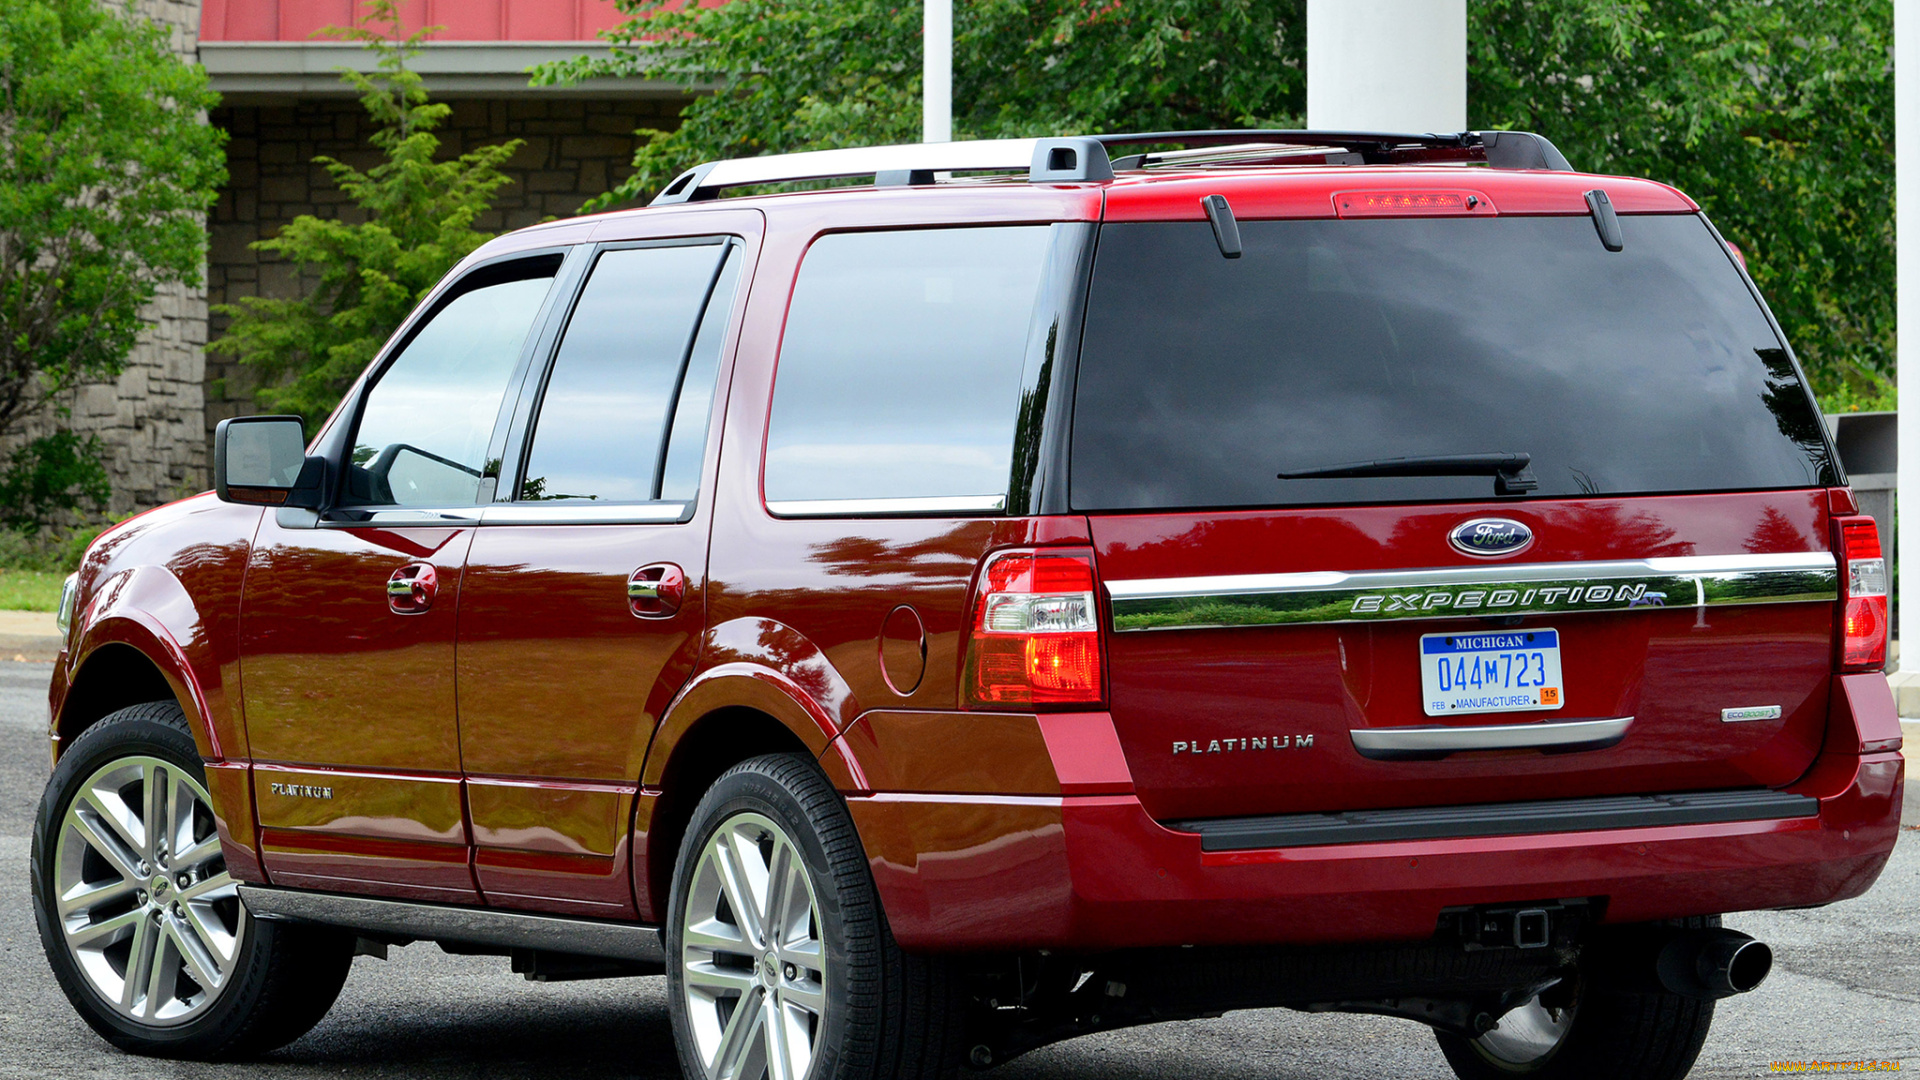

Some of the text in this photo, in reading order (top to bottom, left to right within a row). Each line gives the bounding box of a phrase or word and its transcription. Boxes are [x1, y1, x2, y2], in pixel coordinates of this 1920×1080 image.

[1473, 523, 1515, 545] Ford
[1351, 583, 1647, 613] EXPEDITION
[1456, 635, 1524, 650] MICHIGAN
[1438, 652, 1545, 692] 044M723
[1544, 689, 1556, 698] 15
[1432, 701, 1446, 710] FEB
[1456, 695, 1530, 709] MANUFACTURER
[1727, 710, 1769, 719] ECOBOOST
[1173, 734, 1314, 755] PLATINUM
[271, 782, 334, 799] PLATINUM
